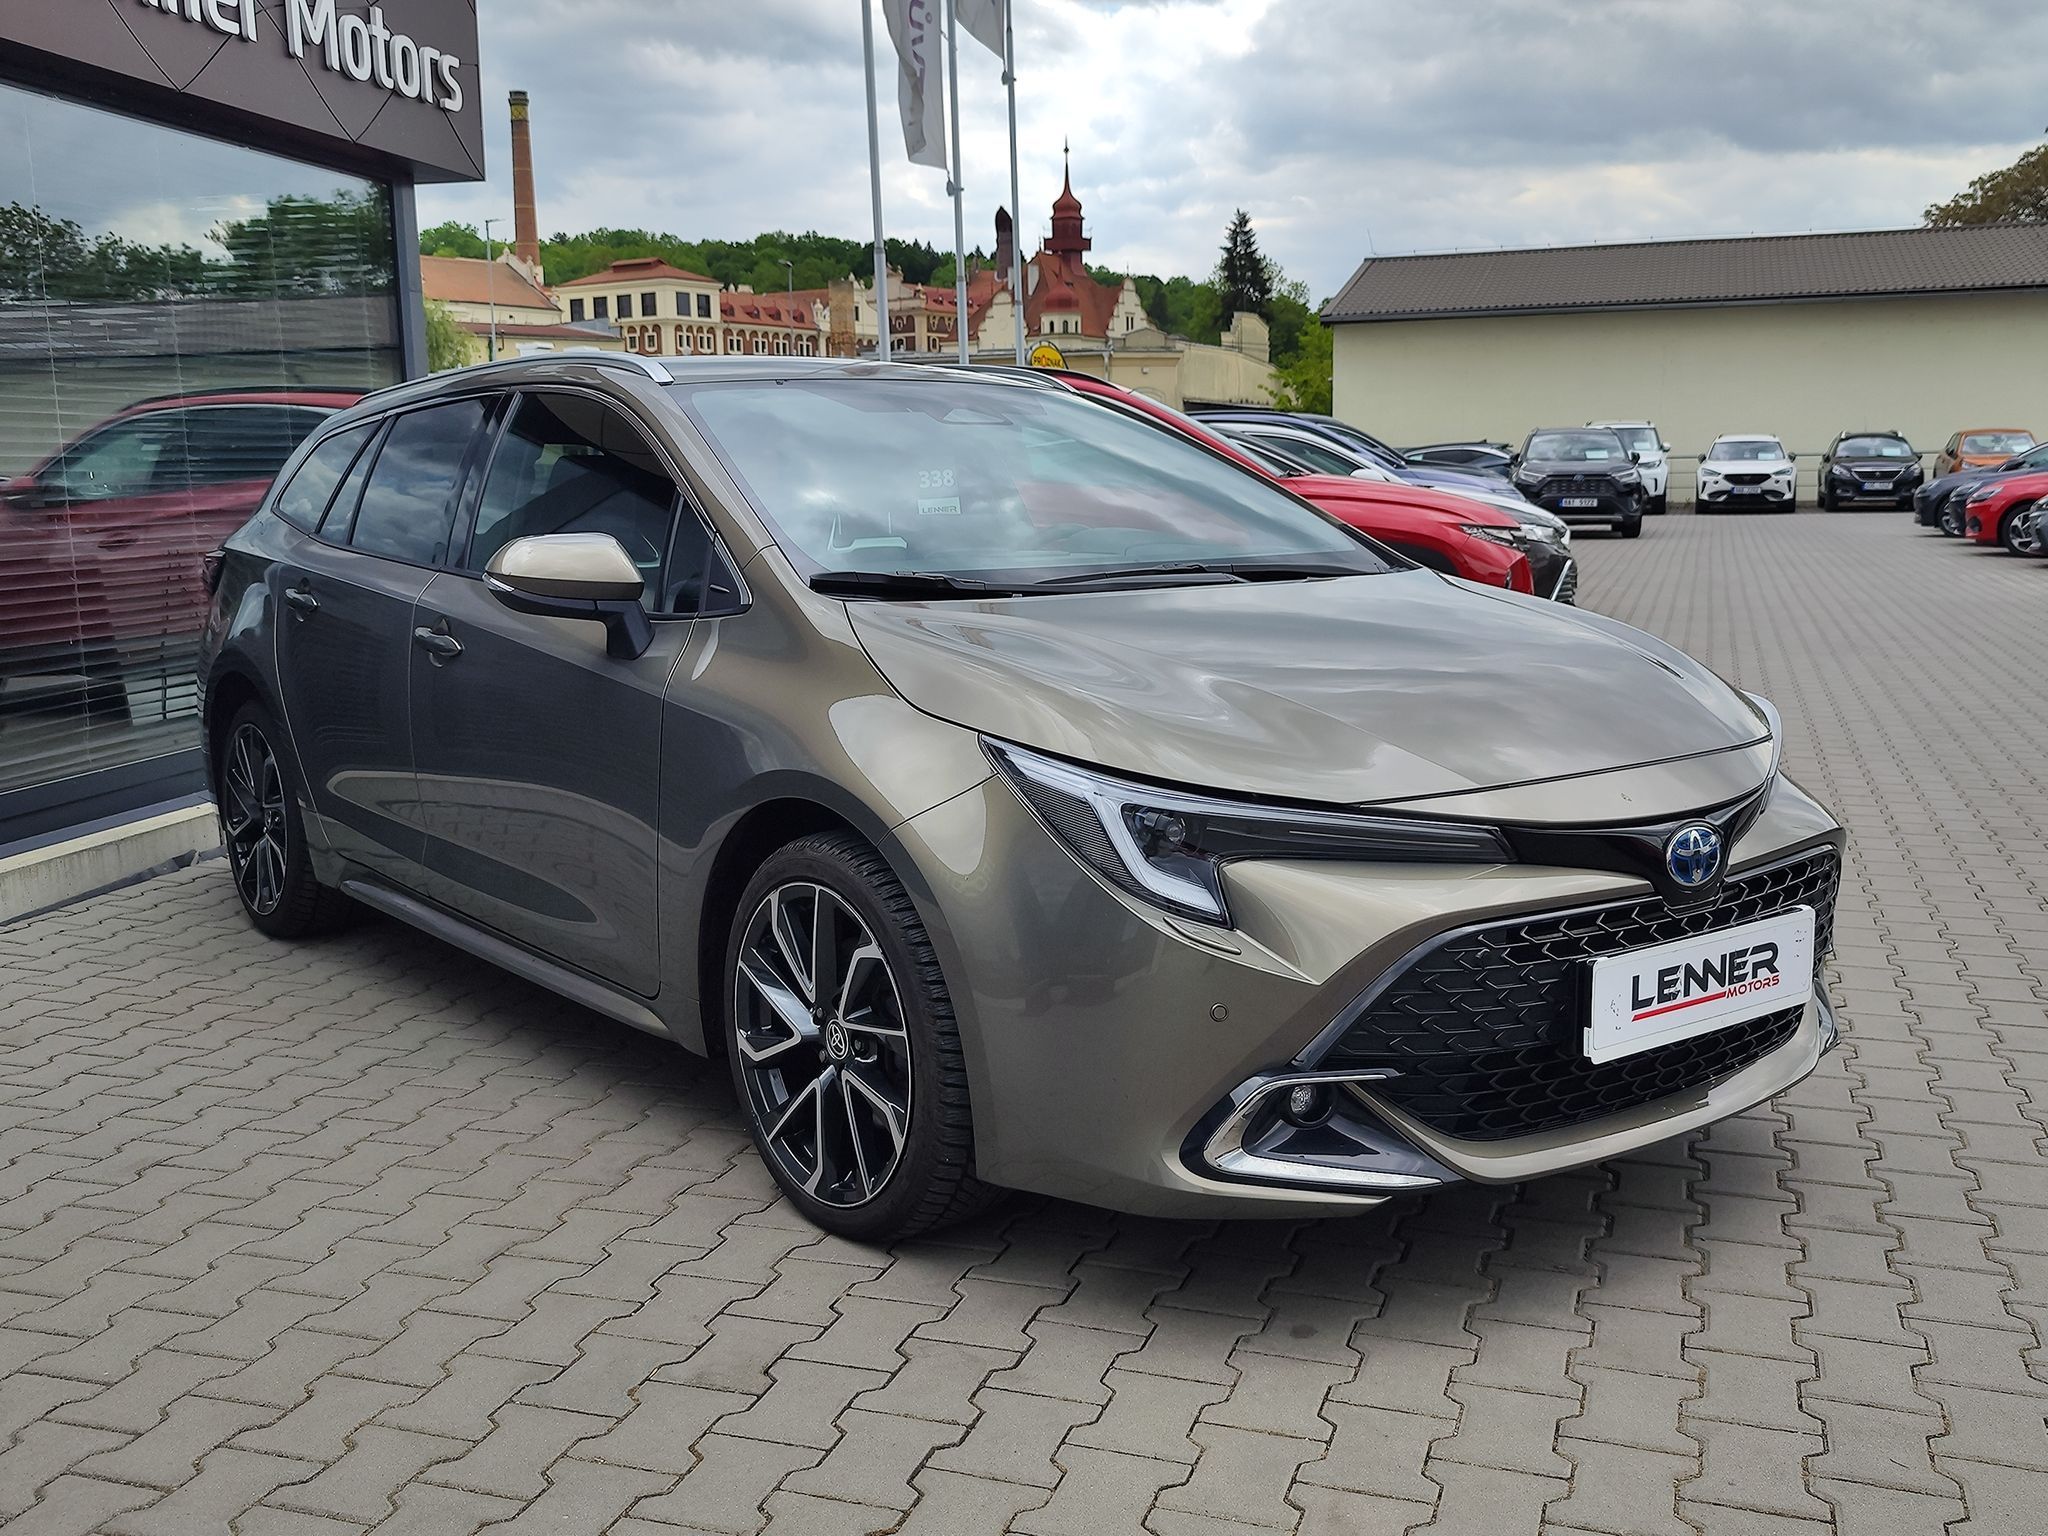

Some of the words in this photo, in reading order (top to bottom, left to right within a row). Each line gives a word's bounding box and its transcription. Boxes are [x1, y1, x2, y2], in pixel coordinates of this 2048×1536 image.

[285, 0, 464, 112] Motors
[918, 469, 955, 489] 338
[922, 505, 958, 514] LENNER
[1631, 941, 1779, 1012] LENNER
[1726, 974, 1780, 999] MOTORS
